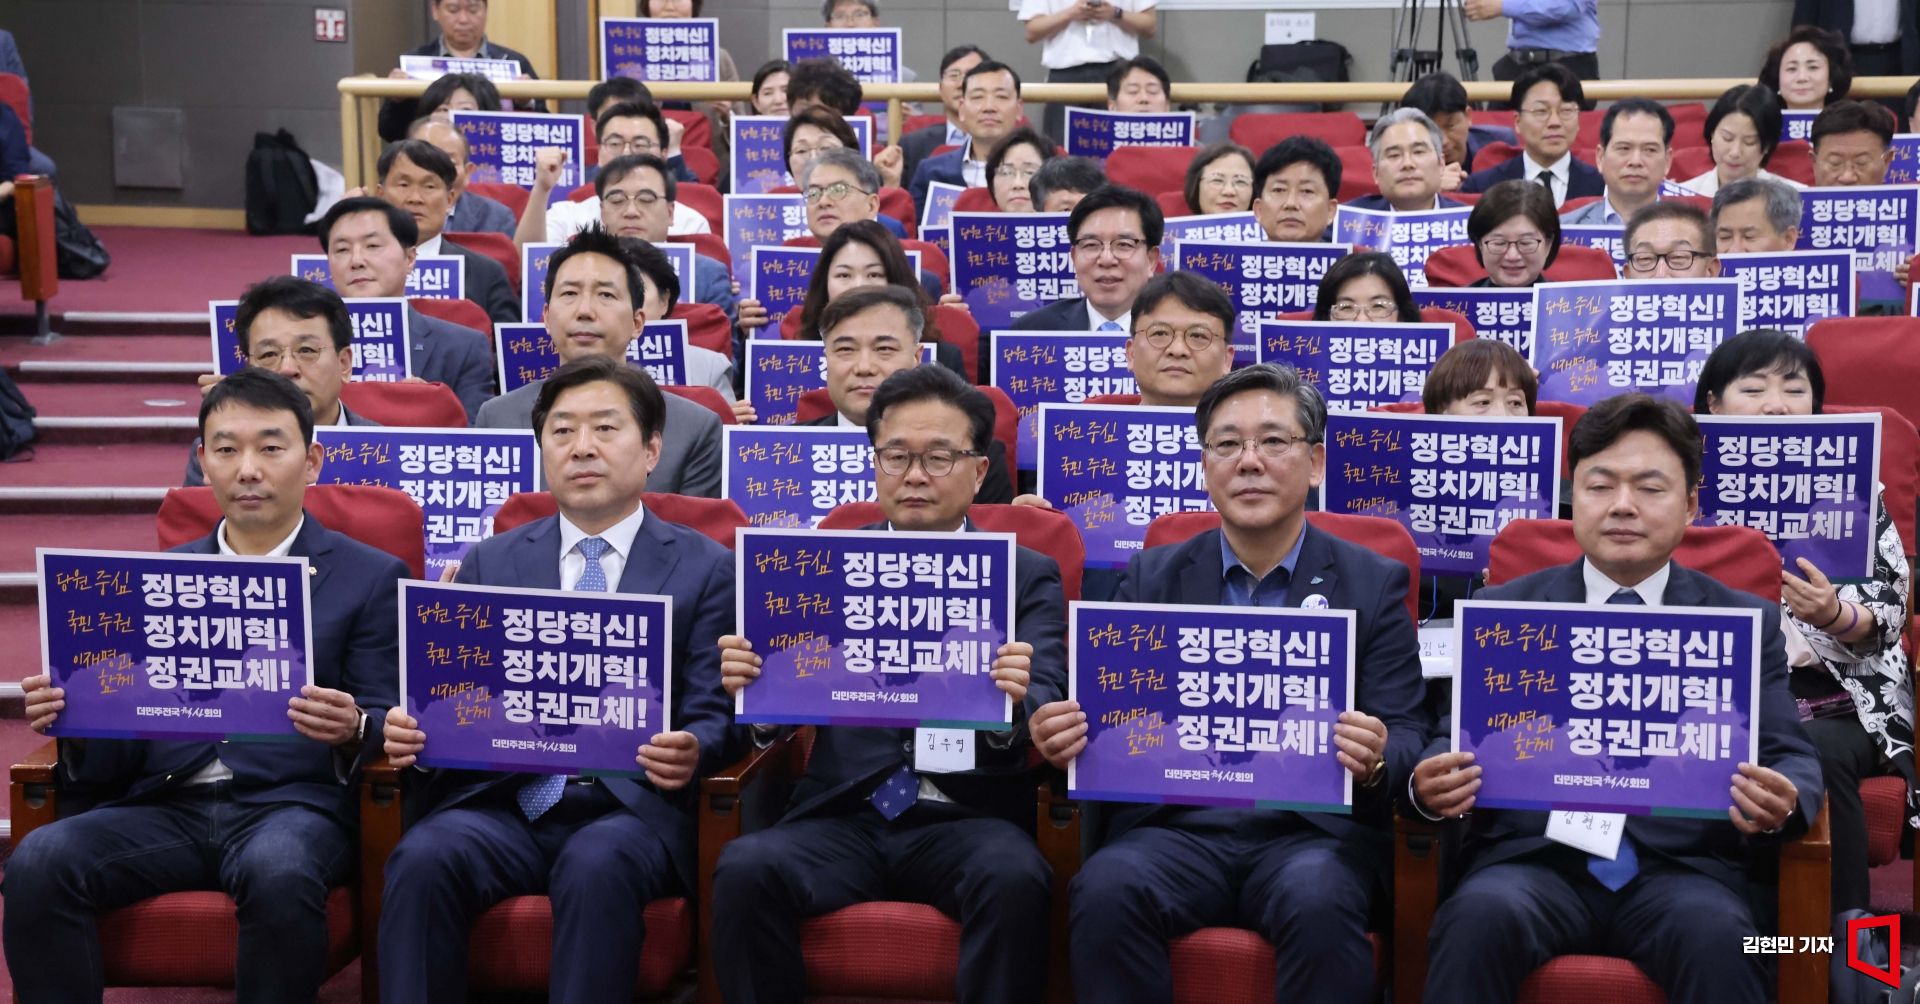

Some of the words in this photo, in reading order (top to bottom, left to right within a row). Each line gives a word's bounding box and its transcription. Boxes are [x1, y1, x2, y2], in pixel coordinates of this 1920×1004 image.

[838, 56, 892, 74] 치개혁!
[501, 123, 572, 143] 정당혁신!
[1114, 122, 1184, 139] 정당혁신!
[1812, 198, 1907, 222] 정당혁신!
[1343, 218, 1362, 235] 당원
[1364, 218, 1386, 237] 중심
[1389, 216, 1468, 245] 정당혁신
[1811, 225, 1906, 247] 정치개혁!
[1855, 251, 1906, 272] 교체!
[1016, 278, 1084, 300] 정권교
[1545, 296, 1572, 316] 당원
[1574, 295, 1602, 317] 중심
[1609, 294, 1724, 322] 정당혁신!
[1267, 334, 1292, 353] 당원
[1293, 334, 1321, 355] 중심
[1550, 327, 1569, 345] 국민
[1573, 326, 1601, 346] 주권
[1608, 327, 1723, 355] 정치개혁!
[758, 356, 784, 372] 당원
[785, 355, 812, 374] 중심
[1003, 347, 1029, 364] 당원
[1030, 346, 1058, 365] 중심
[1329, 337, 1436, 364] 정당혁신!
[1550, 355, 1599, 373] 이재명과
[764, 384, 783, 401] 국민
[1009, 376, 1028, 394] 국민
[1031, 376, 1058, 394] 주권
[1328, 369, 1426, 396] 정치개혁
[1569, 371, 1598, 393] 함께
[766, 412, 797, 425] 이재명
[1053, 421, 1084, 440] 당원
[1086, 421, 1119, 444] 중심
[325, 443, 357, 462] 당원
[358, 443, 391, 465] 중심
[739, 442, 767, 462] 당원
[771, 442, 804, 465] 중심
[1335, 430, 1367, 447] 당원
[1369, 429, 1402, 453] 중심
[1411, 433, 1540, 465] 정당혁신!
[1718, 436, 1857, 467] 정당혁신!
[399, 445, 520, 474] 정당혁신!
[1061, 457, 1084, 478] 국민
[1087, 458, 1119, 479] 주권
[746, 477, 769, 498] 국민
[772, 478, 804, 499] 주권
[1125, 460, 1205, 491] 정치개
[1343, 463, 1367, 482] 국민
[1370, 464, 1402, 485] 주권
[1410, 469, 1538, 502] 정치개혁!
[1063, 490, 1116, 508] 이재명과
[1717, 473, 1856, 504] 정치개혁!
[1084, 507, 1116, 530] 함께
[1346, 497, 1400, 517] 이재명과
[754, 548, 791, 574] 당원
[792, 547, 833, 576] 중심
[843, 552, 991, 589] 정당혁신!
[56, 571, 92, 592] 당원
[94, 568, 134, 597] 중심
[142, 574, 286, 609] 정당혁신!
[416, 602, 453, 626] 당원
[455, 602, 494, 629] 중심
[763, 589, 793, 617] 국민
[795, 591, 835, 618] 주권
[843, 595, 990, 632] 정치개혁!
[66, 609, 95, 636] 국민
[97, 609, 136, 637] 주권
[144, 615, 288, 651] 정치개혁!
[503, 609, 647, 647] 정당혁신!
[1086, 624, 1126, 649] 당원
[1127, 622, 1169, 652] 중심
[1472, 623, 1515, 649] 당원
[1516, 622, 1560, 651] 중심
[769, 628, 833, 652] 이재명과
[1178, 628, 1330, 667] 정당혁신!
[1570, 627, 1733, 668] 정당혁신!
[71, 650, 136, 675] 이재명과
[425, 641, 455, 667] 국민
[456, 642, 495, 670] 주권
[793, 648, 832, 677] 함께
[842, 638, 994, 676] 정권교체!
[96, 668, 135, 696] 함께
[145, 656, 290, 692] 정권교체!
[503, 650, 647, 690] 정치개혁!
[1096, 664, 1126, 693] 국민
[1127, 665, 1170, 694] 주권
[1483, 666, 1512, 695] 국민
[1516, 667, 1560, 698] 주권
[428, 683, 493, 705] 이재명과
[1177, 672, 1329, 712] 정치개혁!
[1568, 673, 1733, 715] 정치개혁!
[454, 699, 493, 728] 함께
[502, 690, 647, 730] 정권교체!
[1100, 705, 1168, 730] 이재명과
[1485, 710, 1556, 734] 이재명과
[1127, 726, 1166, 756] 함께
[1176, 715, 1328, 756] 정권교체!
[1512, 732, 1554, 761] 함께
[1567, 718, 1732, 761] 정권교체!
